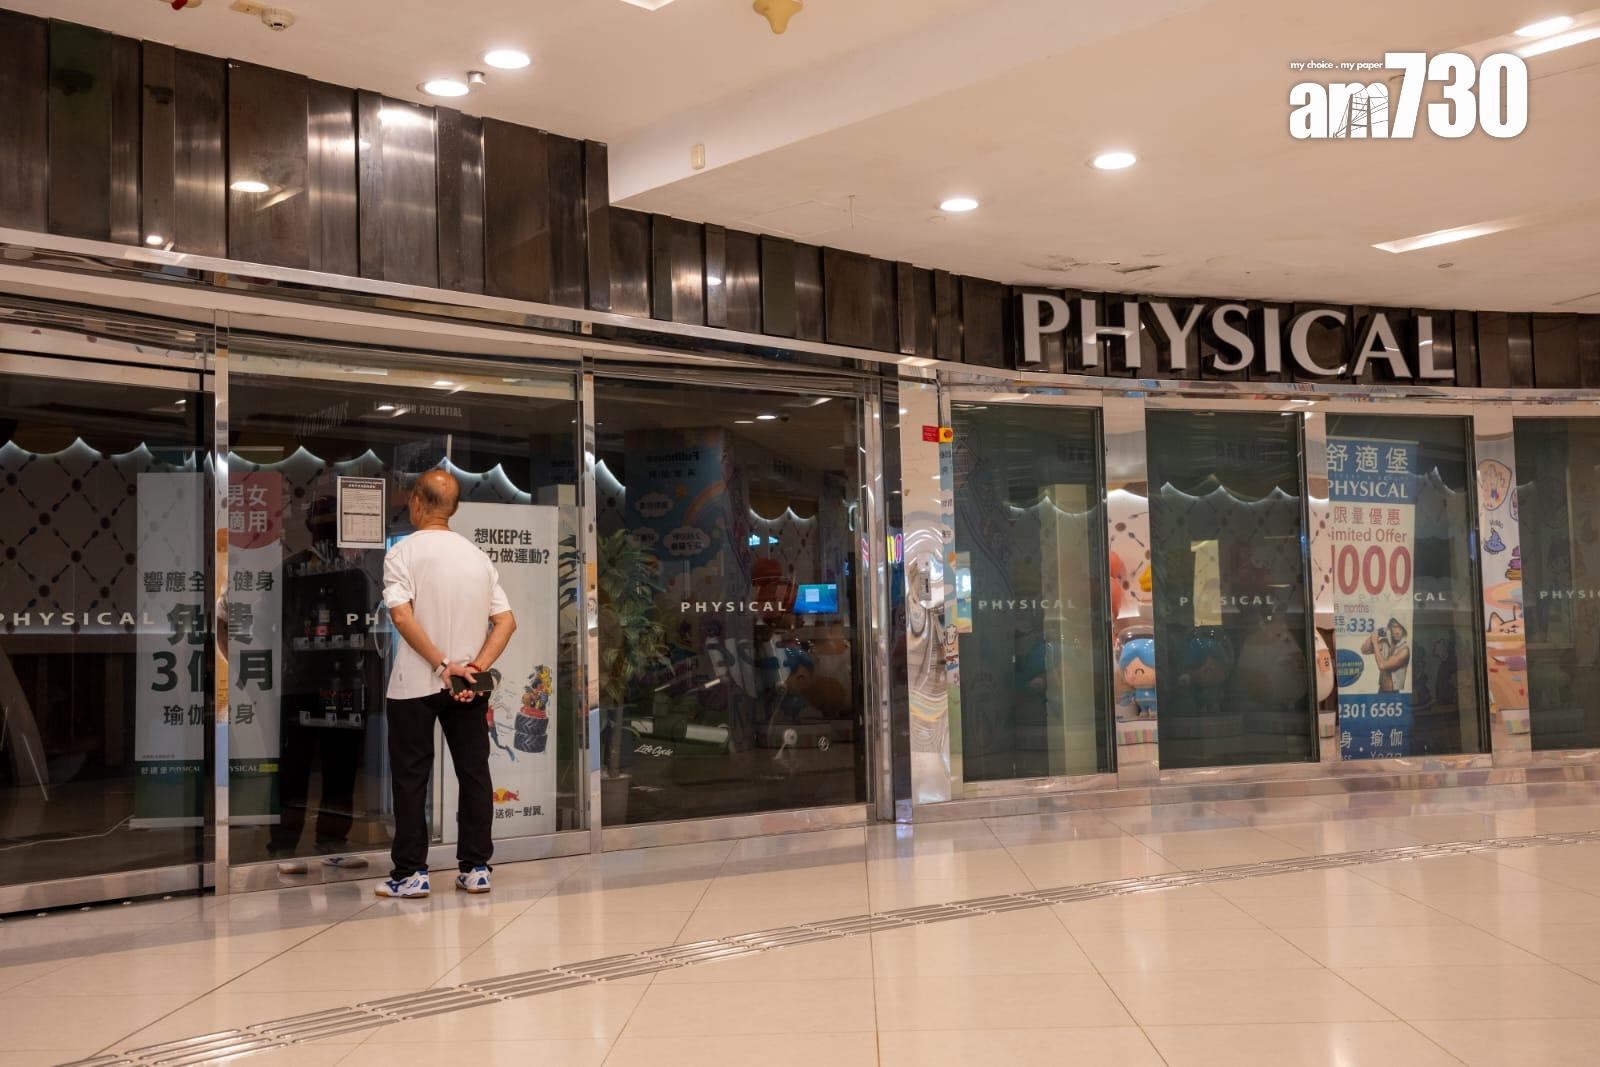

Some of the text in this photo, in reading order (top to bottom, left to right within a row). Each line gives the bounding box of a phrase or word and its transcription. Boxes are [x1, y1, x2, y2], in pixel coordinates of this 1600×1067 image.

[1022, 293, 1455, 379] PHYSICAL
[1327, 443, 1409, 474] 舒適堡
[1333, 506, 1401, 526] 限量優惠
[474, 528, 532, 545] 想KEEP住
[1331, 527, 1407, 543] imited Offer
[484, 547, 550, 564] 力做運動?
[144, 570, 274, 592] 響應全健身
[681, 601, 786, 613] PHYSICAL
[978, 599, 1076, 610] PHYSICAL
[1179, 595, 1274, 606] PSICAL
[151, 649, 273, 693] 3月
[163, 703, 255, 726] 瑜伽身
[1370, 702, 1403, 718] 6565
[1370, 728, 1403, 747] 瑜伽
